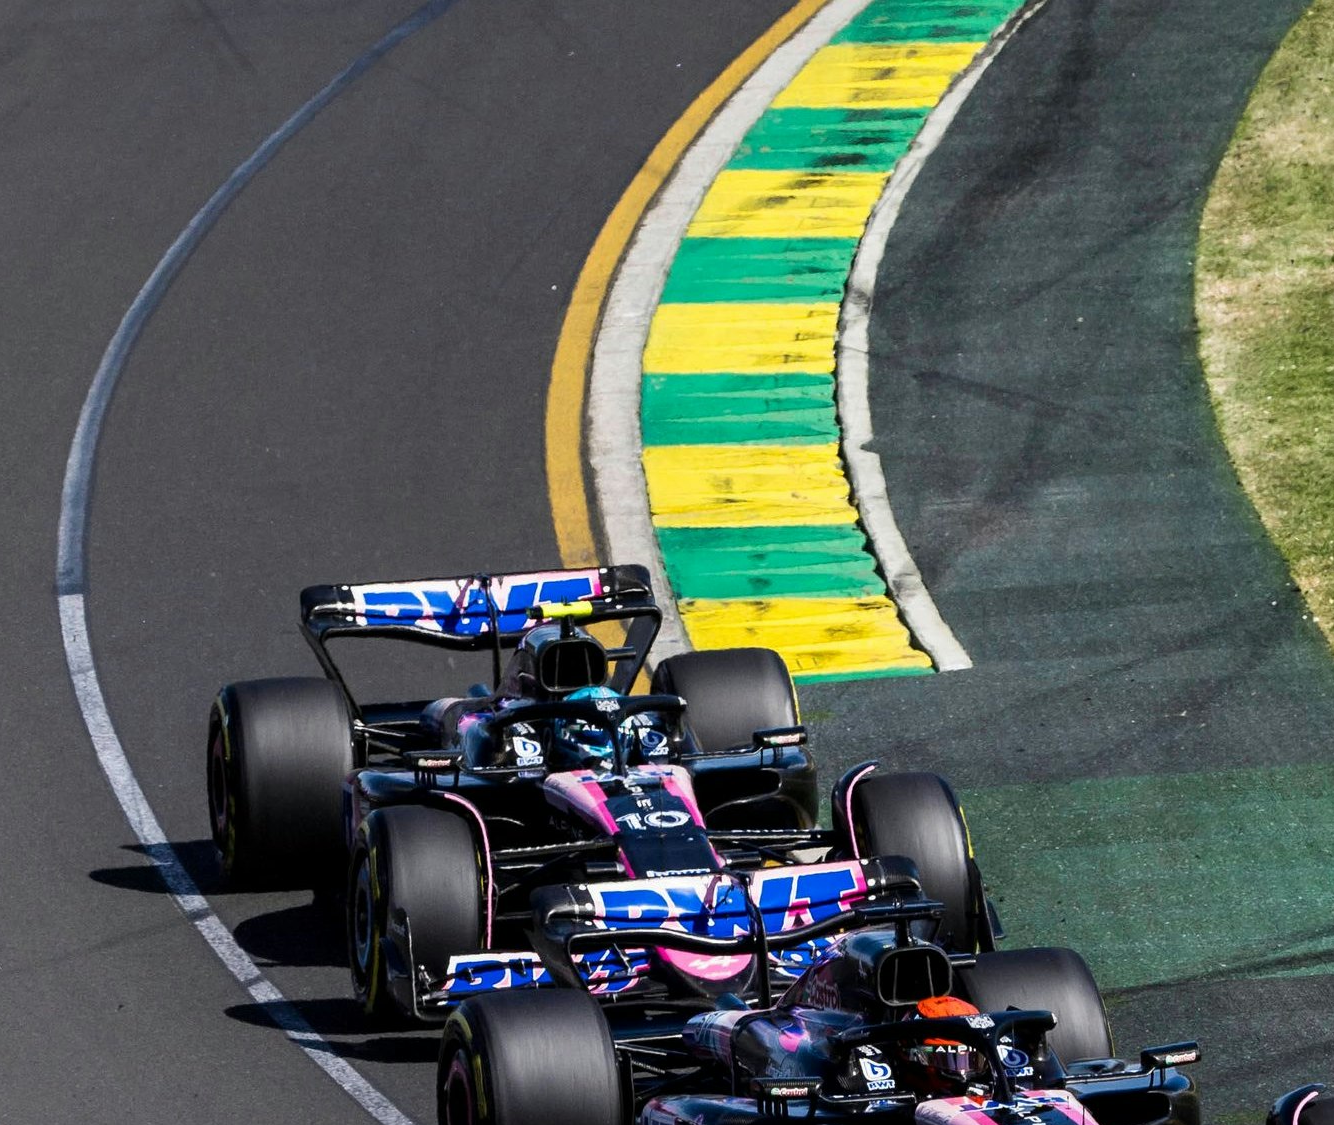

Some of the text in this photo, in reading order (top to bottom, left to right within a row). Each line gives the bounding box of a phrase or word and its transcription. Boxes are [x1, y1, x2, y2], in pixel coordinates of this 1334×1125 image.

[361, 576, 593, 635] BWT
[615, 811, 691, 831] 10
[598, 868, 856, 938] BWT
[867, 1079, 895, 1091] BWT
